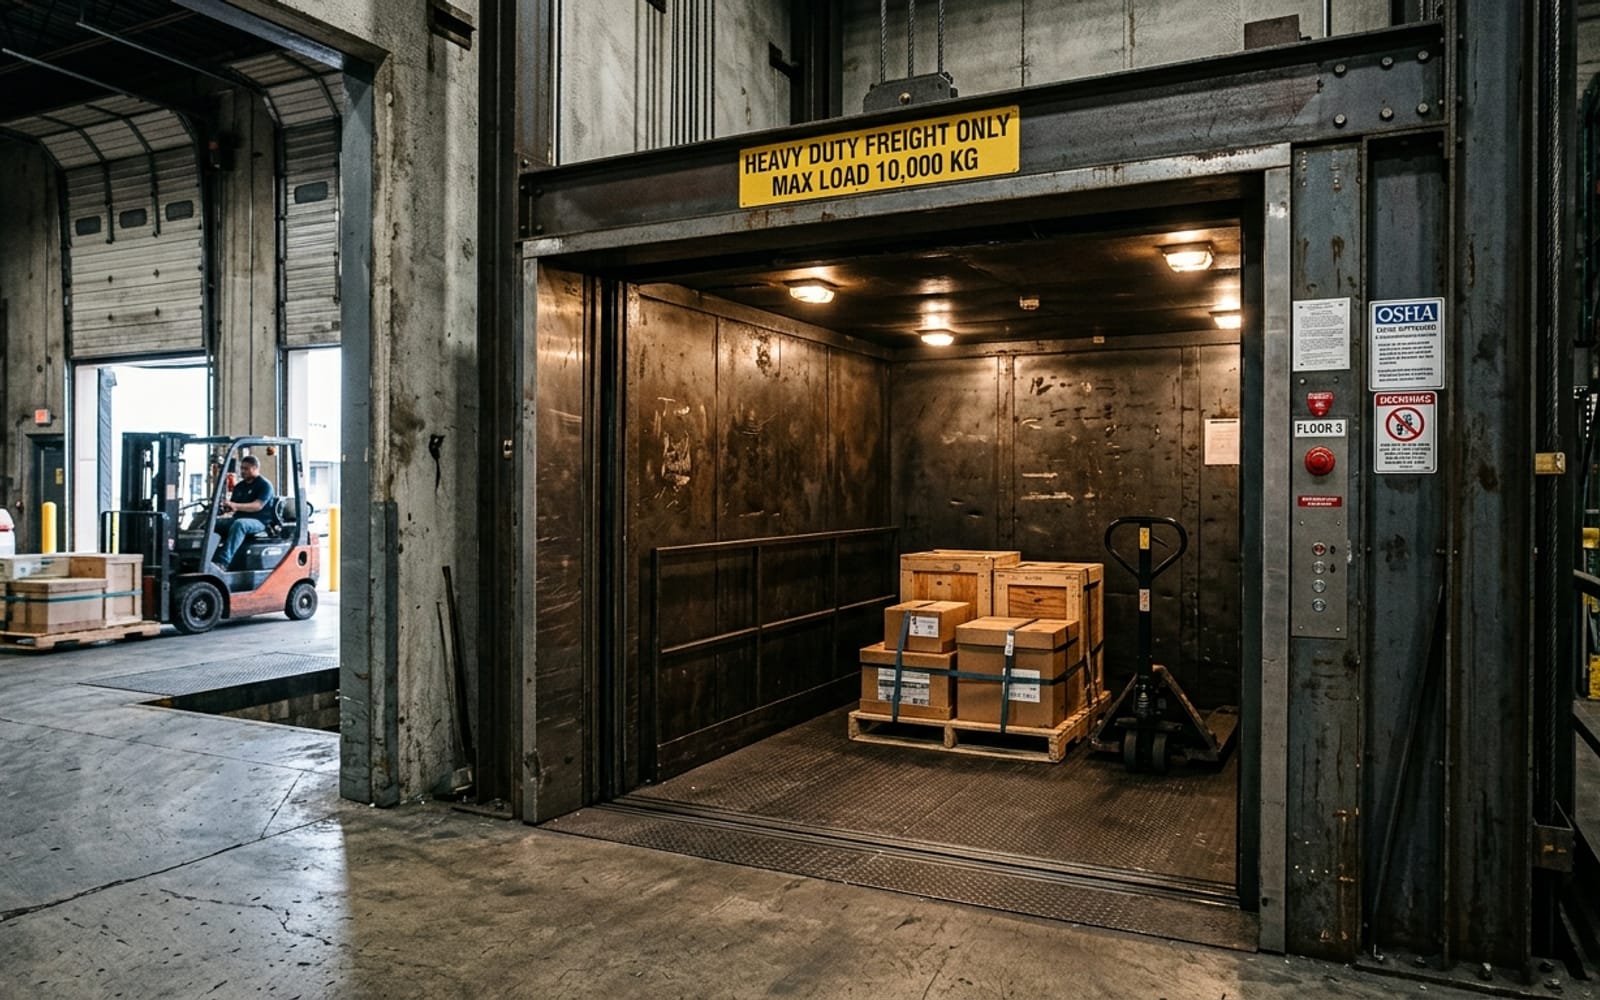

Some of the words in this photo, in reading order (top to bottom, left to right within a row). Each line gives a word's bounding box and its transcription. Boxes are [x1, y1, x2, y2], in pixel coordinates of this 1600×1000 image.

[745, 147, 802, 175] HEAVY
[809, 138, 859, 164] DUTY
[866, 124, 949, 155] FREIGHT
[956, 113, 1010, 142] ONLY
[772, 173, 813, 197] MAX
[820, 163, 869, 190] LOAD
[876, 153, 943, 183] 10,000
[950, 148, 978, 173] KG
[1378, 305, 1435, 322] OSHA
[1297, 423, 1333, 434] FLOOR
[1336, 423, 1343, 433] 3
